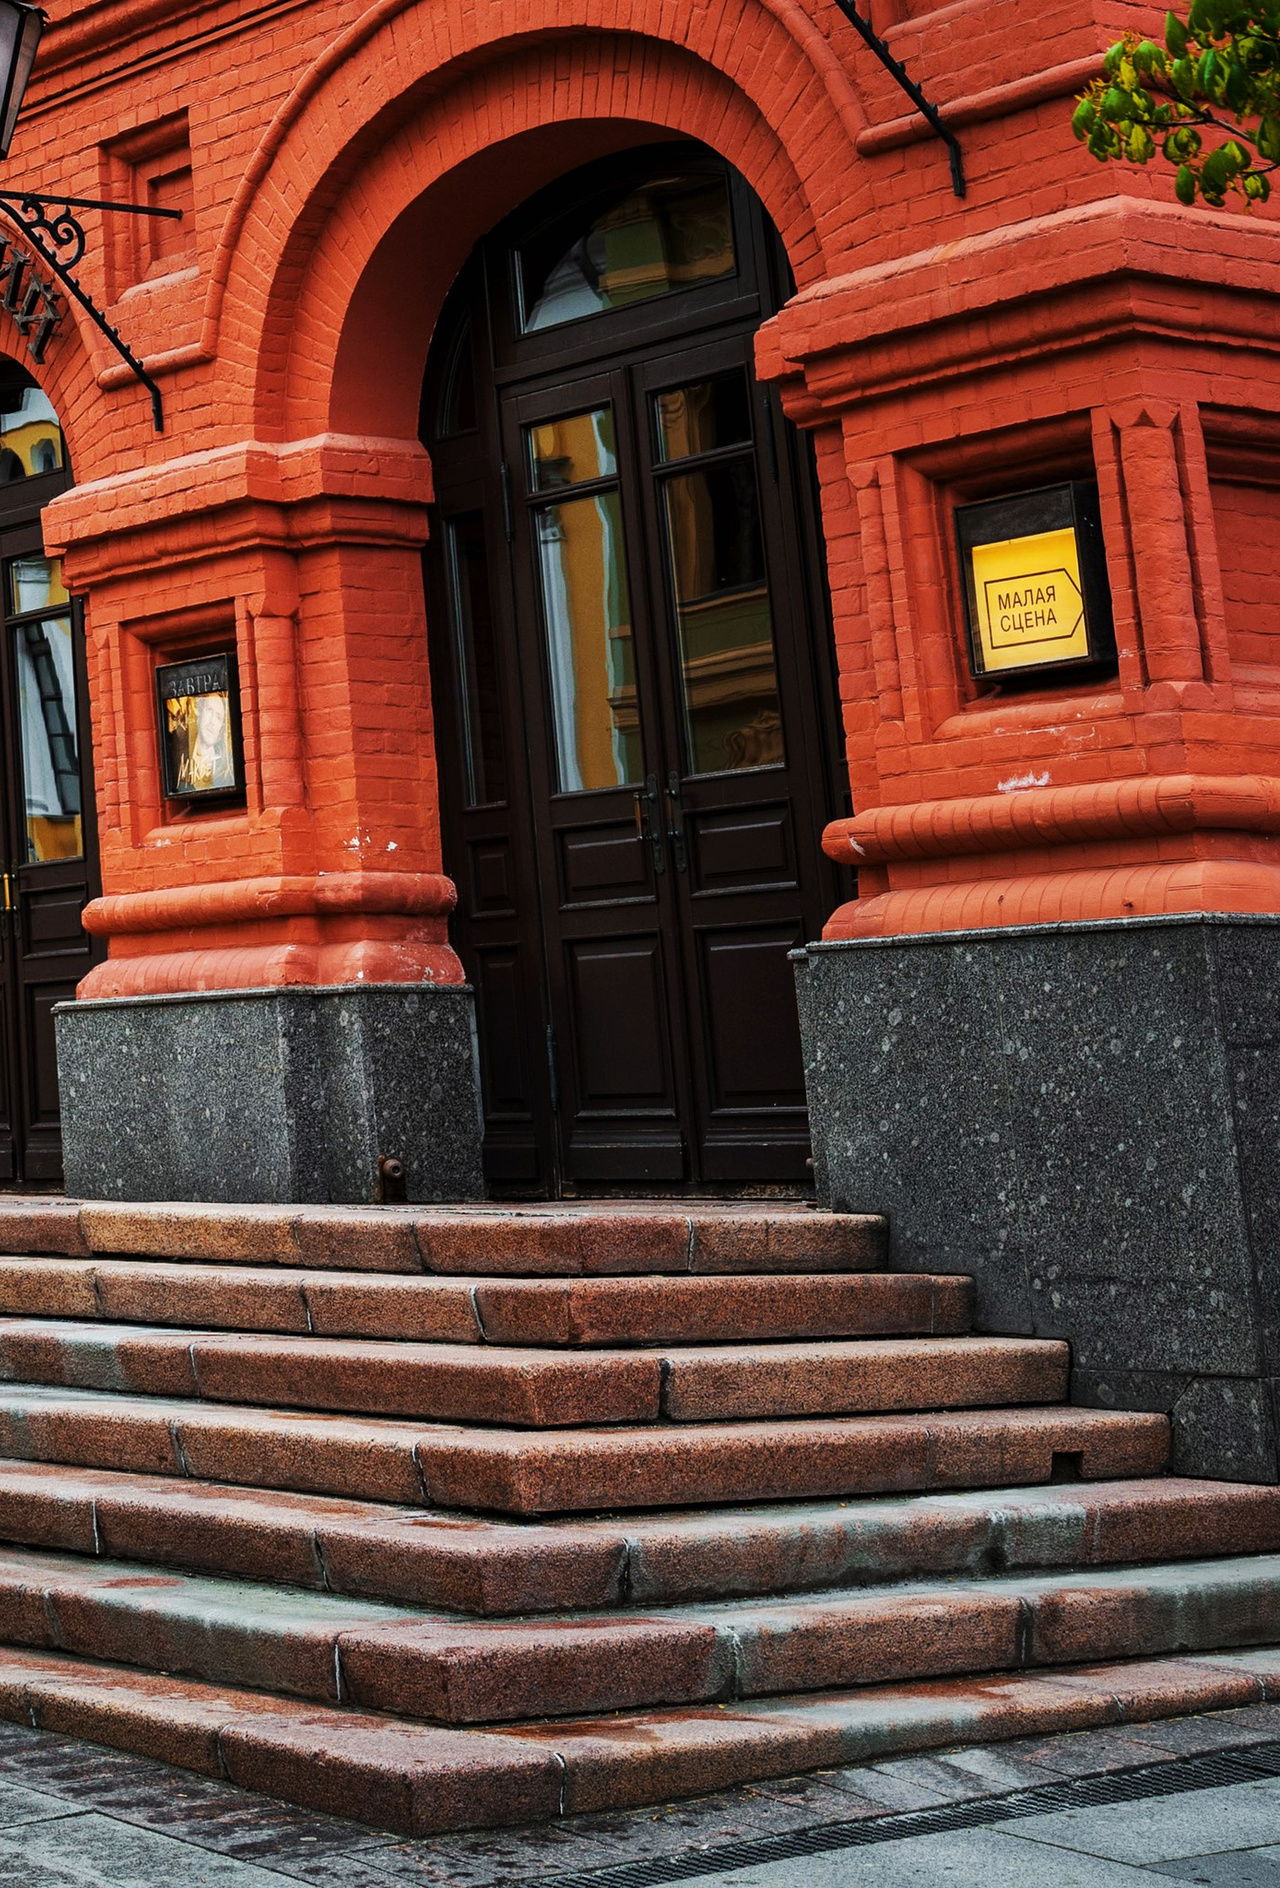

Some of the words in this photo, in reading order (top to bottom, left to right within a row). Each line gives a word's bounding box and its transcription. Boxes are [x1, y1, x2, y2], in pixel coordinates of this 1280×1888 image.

[997, 585, 1056, 610] МАЛАЯ
[1000, 608, 1057, 633] СЦЕНА
[169, 674, 221, 697] ЗАВТРА
